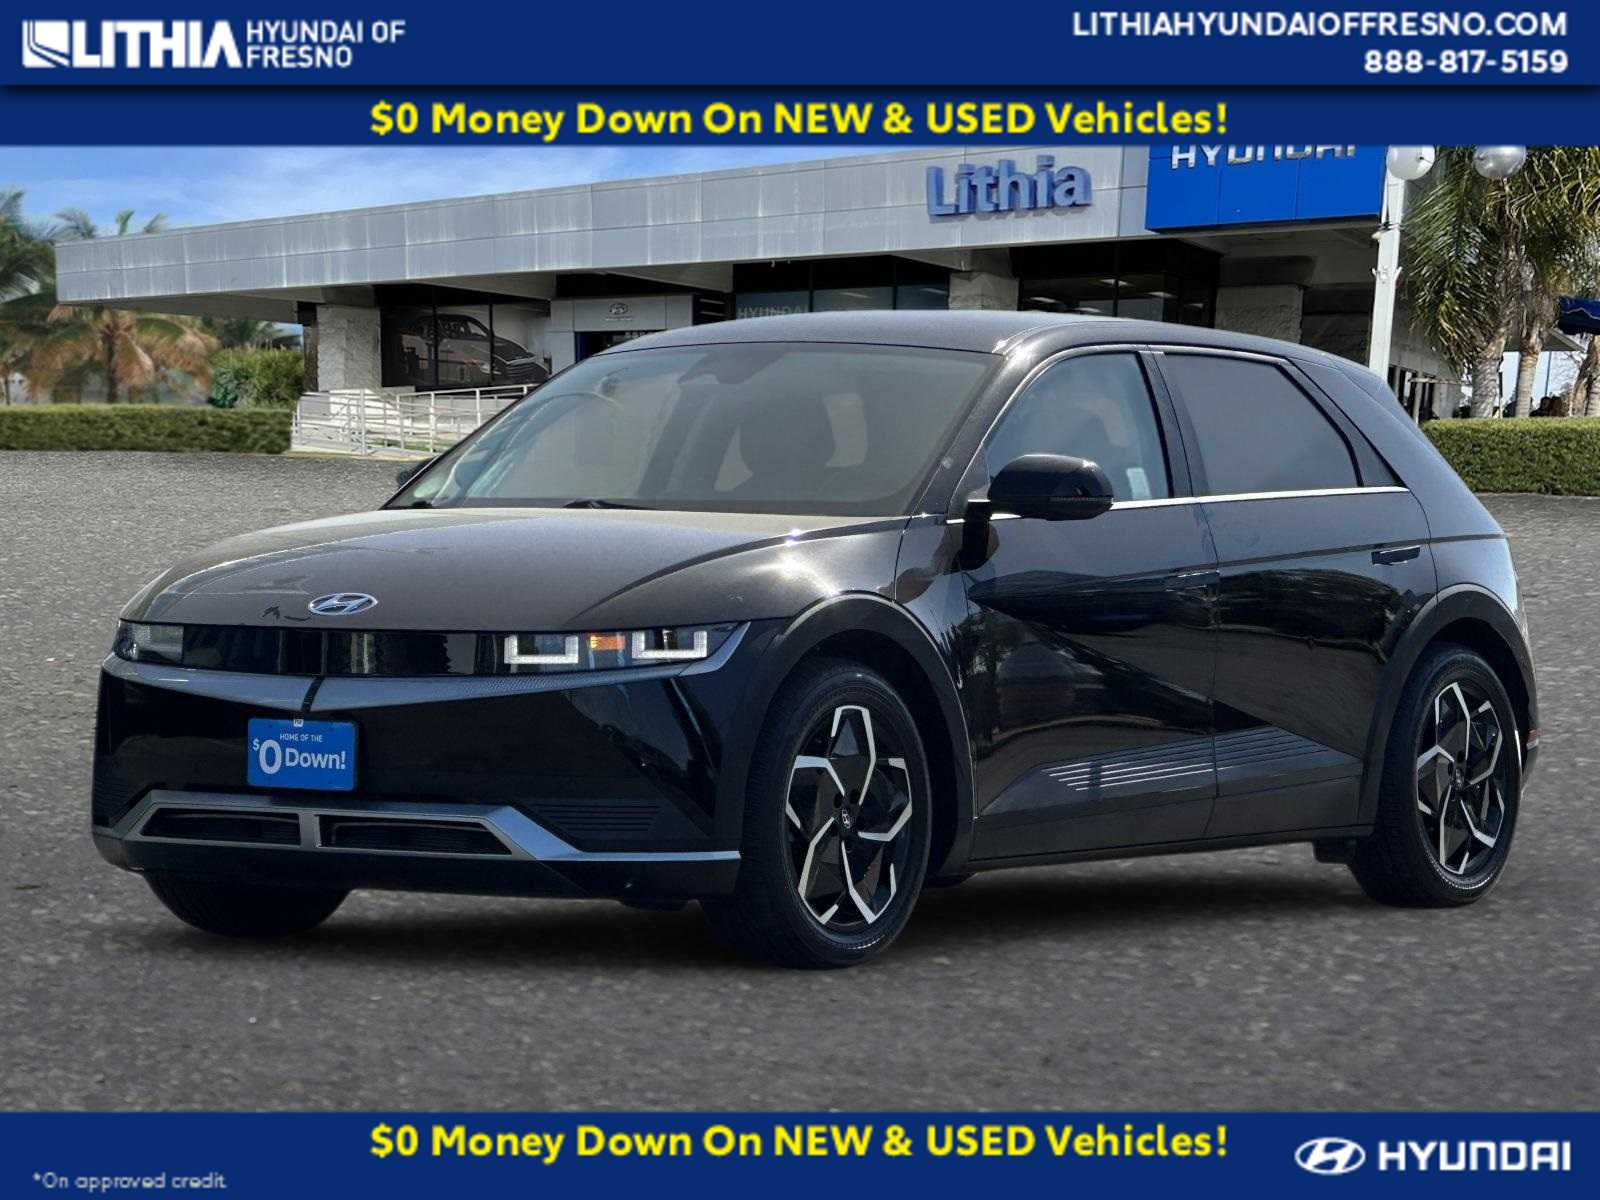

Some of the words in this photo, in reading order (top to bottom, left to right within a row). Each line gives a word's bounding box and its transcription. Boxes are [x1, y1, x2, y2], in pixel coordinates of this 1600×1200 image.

[926, 154, 1092, 215] Lithia
[280, 733, 299, 742] HOME
[300, 733, 309, 742] OF
[310, 734, 323, 743] THE
[284, 747, 346, 770] Down!
